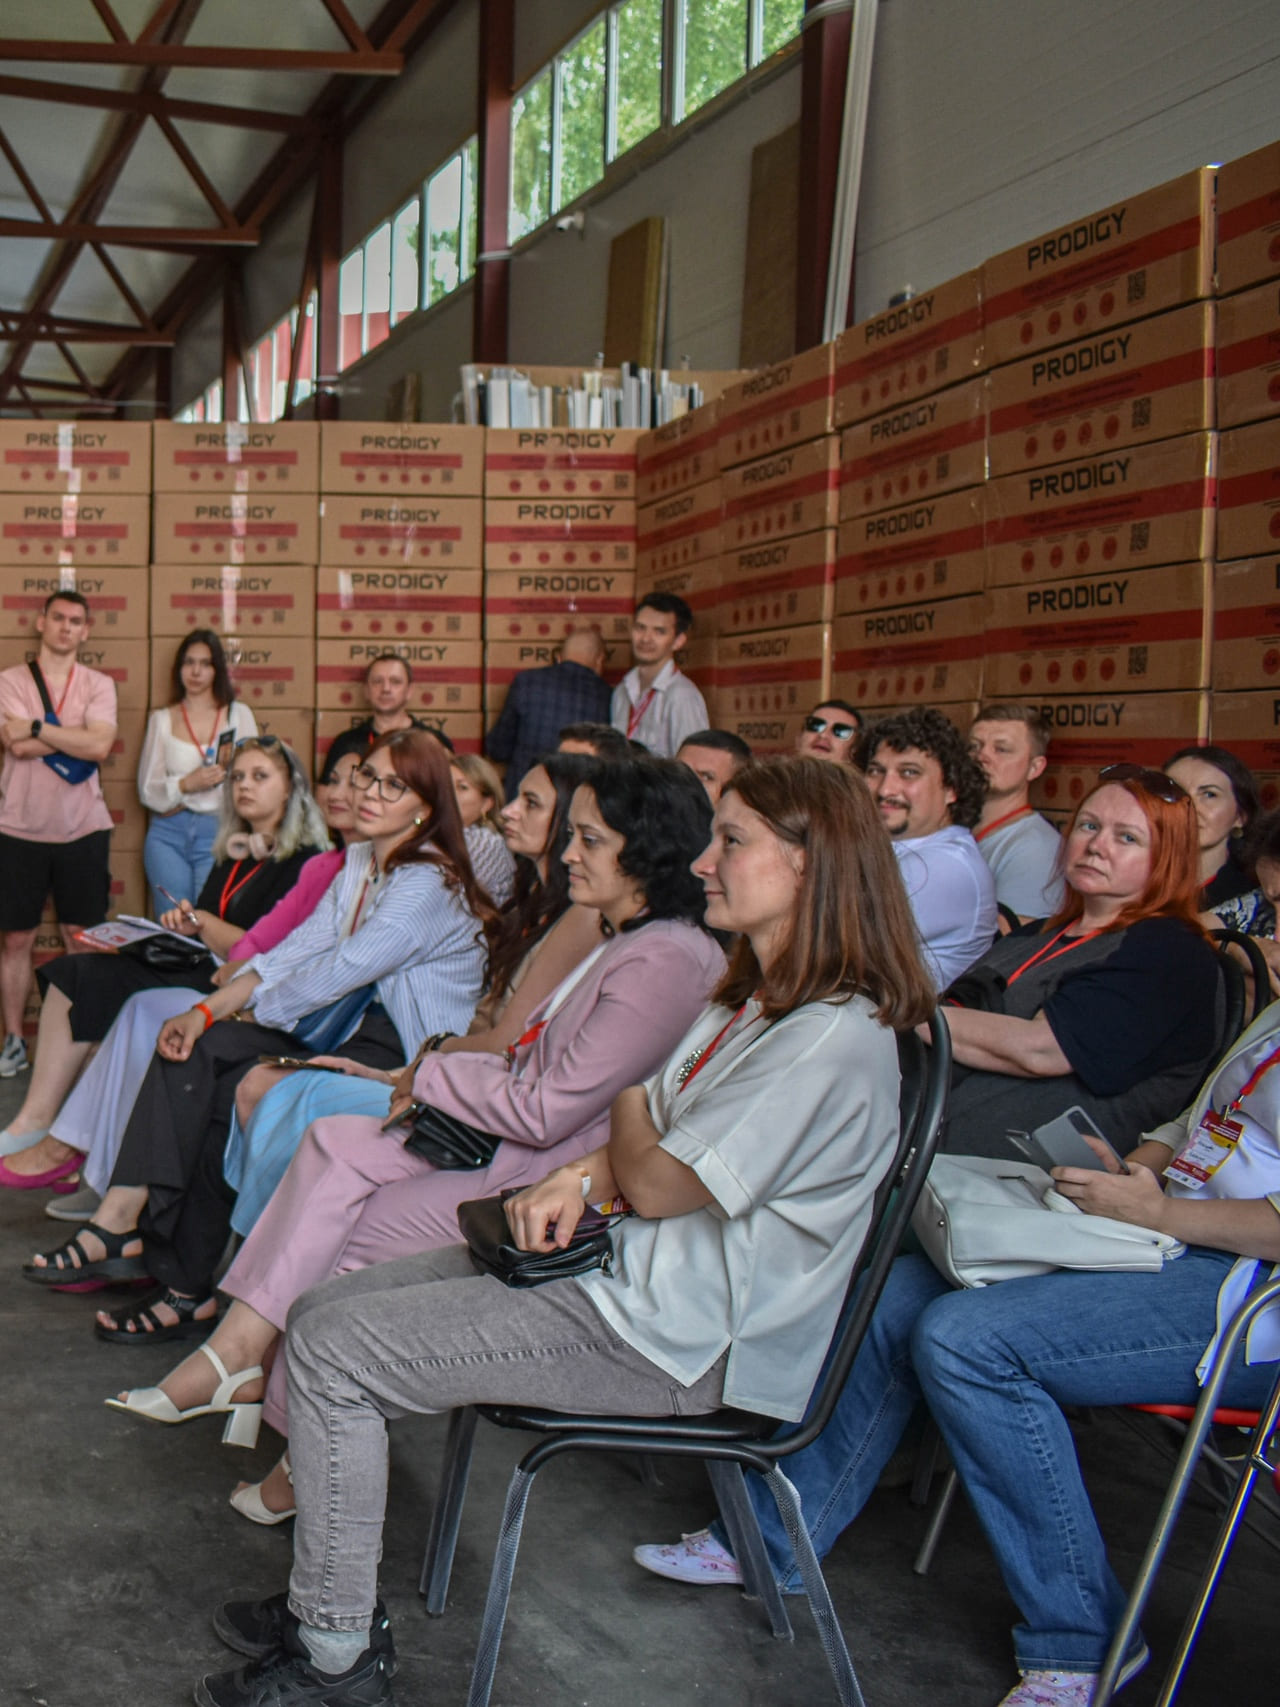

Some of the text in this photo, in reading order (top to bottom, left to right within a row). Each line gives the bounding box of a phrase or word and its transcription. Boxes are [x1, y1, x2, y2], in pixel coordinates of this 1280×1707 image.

[1028, 207, 1126, 271] PRODIGY
[865, 295, 935, 345] PRODIGY
[1033, 333, 1131, 386] PRODIGY
[871, 402, 937, 442] PRODIGY
[361, 435, 441, 449] PRODIGY
[742, 454, 794, 485] PRODIGY
[1029, 457, 1131, 500] PRODIGY
[360, 508, 440, 522] PRODIGY
[518, 504, 615, 520] PRODIGY
[865, 506, 935, 540] PRODIGY
[738, 545, 790, 571] PRODIGY
[351, 573, 448, 590] PRODIGY
[518, 576, 615, 592] PRODIGY
[1027, 580, 1129, 614] PRODIGY
[865, 610, 935, 638] PRODIGY
[739, 637, 791, 658] PRODIGY
[737, 721, 787, 740] PRODIGY
